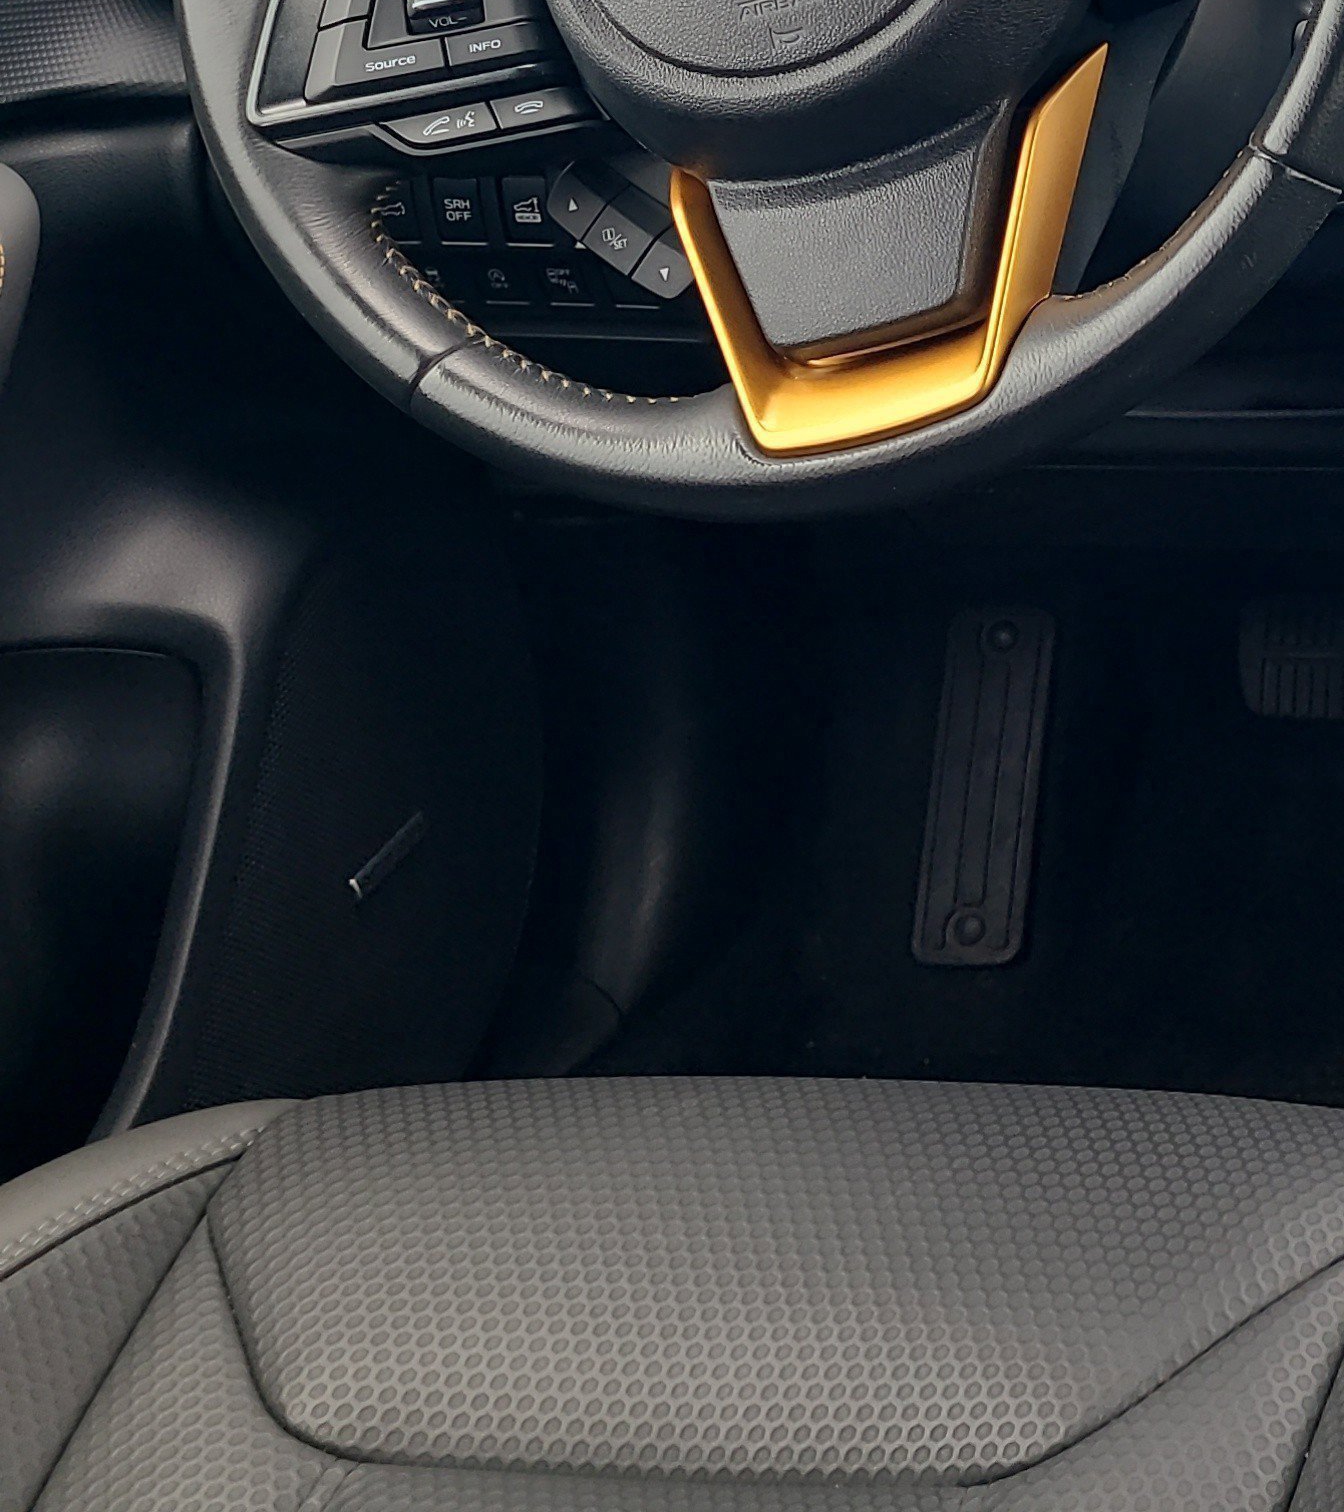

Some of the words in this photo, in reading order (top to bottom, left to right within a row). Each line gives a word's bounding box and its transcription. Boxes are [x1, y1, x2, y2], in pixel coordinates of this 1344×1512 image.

[469, 39, 502, 53] INFO
[365, 55, 416, 72] Source
[444, 198, 470, 210] SRH
[446, 210, 472, 222] OFF
